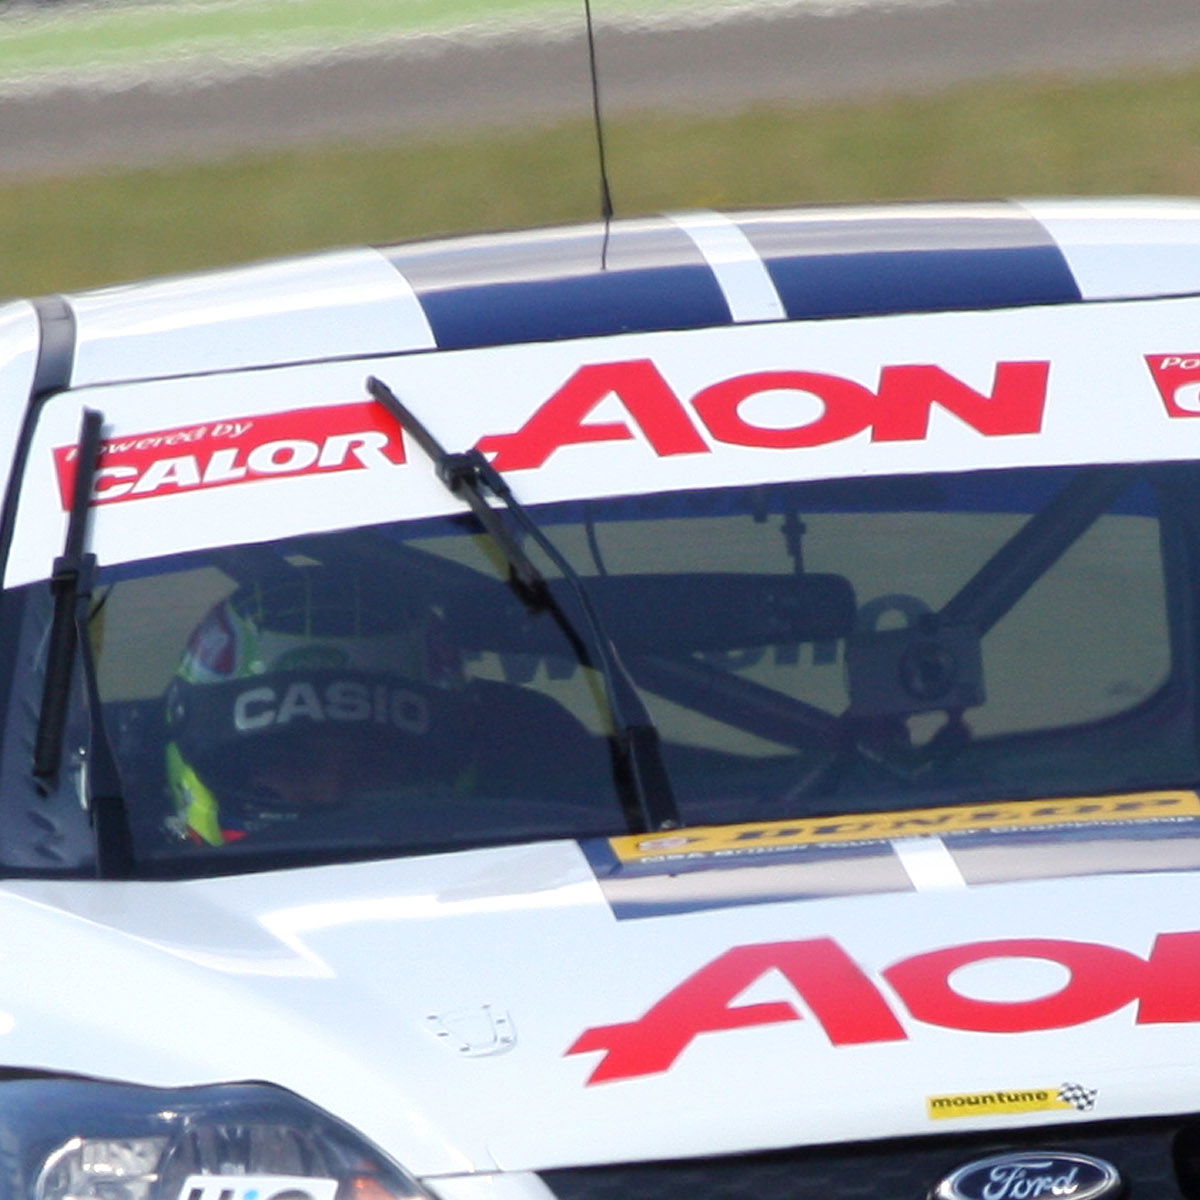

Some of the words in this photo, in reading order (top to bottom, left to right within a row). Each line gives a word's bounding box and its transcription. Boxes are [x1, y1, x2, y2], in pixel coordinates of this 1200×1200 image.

[211, 421, 253, 438] by
[477, 358, 1051, 473] AON
[91, 430, 405, 499] CALOR
[233, 682, 430, 733] CASIO
[931, 1092, 1049, 1109] mountune
